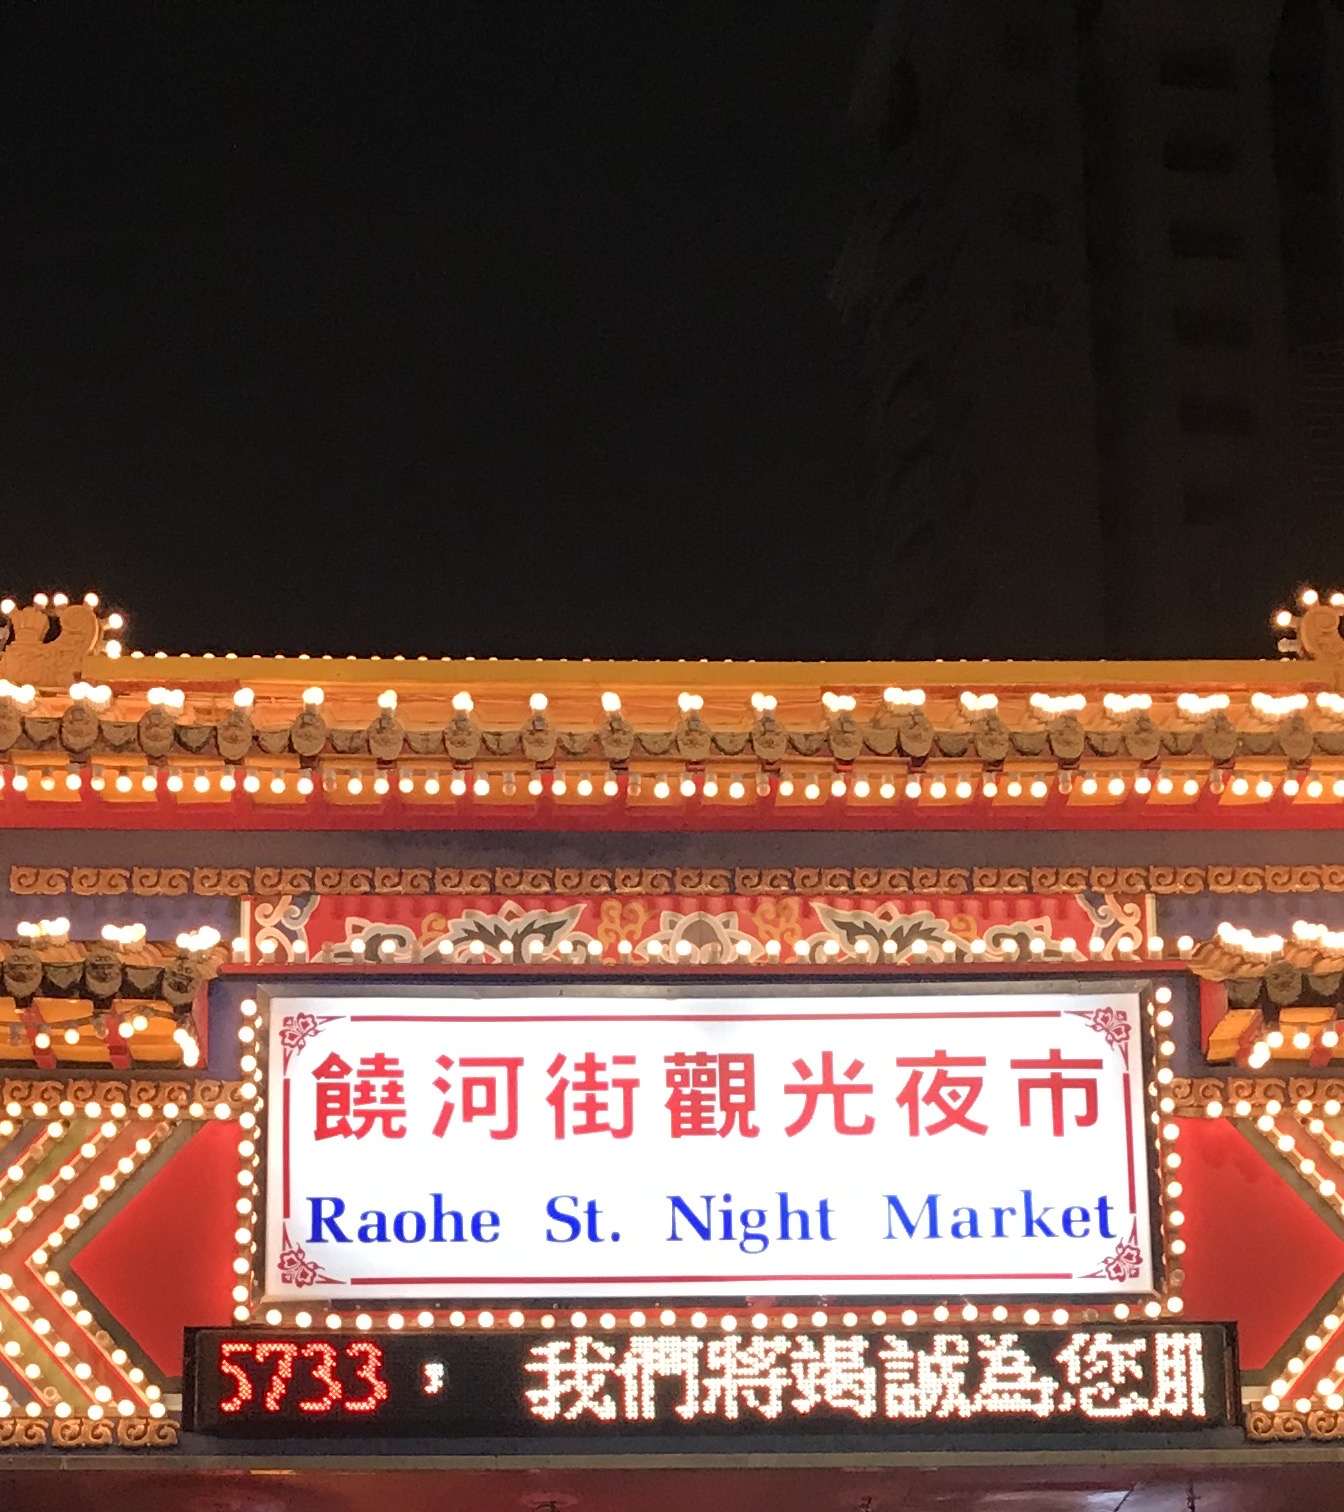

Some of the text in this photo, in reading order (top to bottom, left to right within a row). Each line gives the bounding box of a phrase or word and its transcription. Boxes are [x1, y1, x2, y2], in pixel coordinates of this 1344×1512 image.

[312, 1049, 1104, 1140] 饒河街觀光夜市
[307, 1189, 1118, 1253] Raohe St. Night Market
[219, 1341, 389, 1413] 5733
